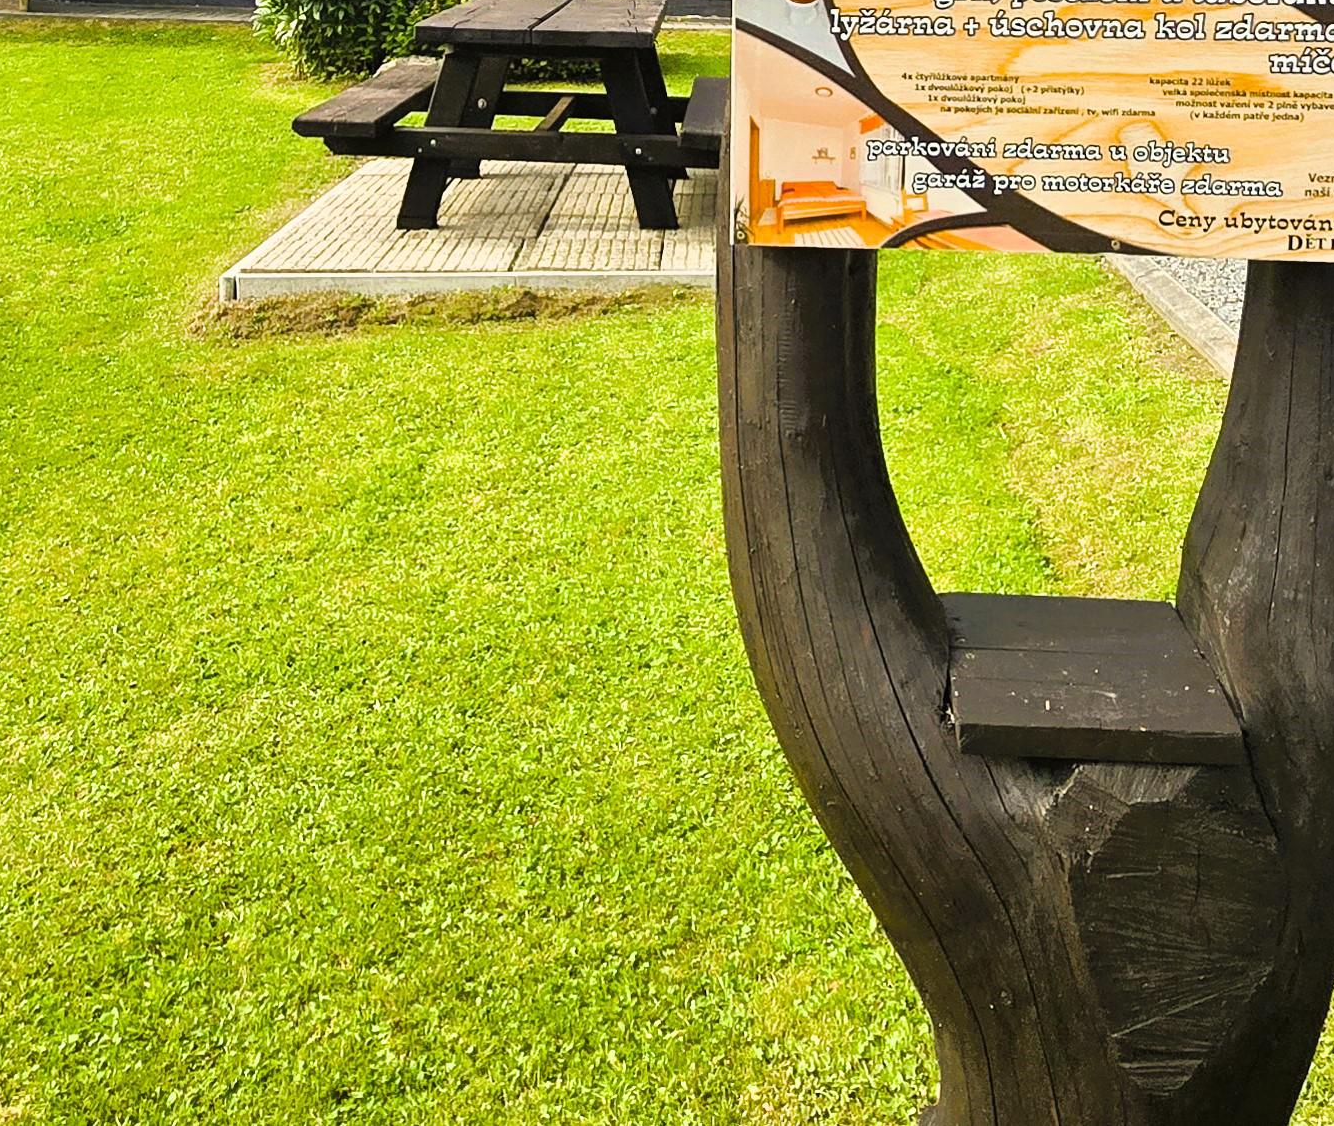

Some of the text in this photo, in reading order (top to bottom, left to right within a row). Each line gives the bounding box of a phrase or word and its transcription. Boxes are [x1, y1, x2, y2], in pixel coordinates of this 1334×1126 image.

[829, 7, 956, 42] lyžárna
[963, 17, 981, 36] +
[987, 10, 1147, 40] úschovna
[1154, 12, 1207, 41] kol
[901, 72, 913, 80] 4x
[970, 74, 1020, 84] apartmány
[1149, 77, 1189, 87] kapacita
[1191, 77, 1204, 86] 22
[915, 83, 926, 91] 1x
[987, 86, 1013, 94] pokoj
[928, 94, 938, 102] 1x
[1000, 95, 1026, 105] pokoj
[1162, 88, 1187, 96] velká
[1293, 91, 1333, 102] kapacita
[1175, 99, 1217, 108] možnost
[940, 105, 952, 113] na
[995, 106, 1004, 115] je
[1101, 108, 1119, 116] wifi
[1121, 108, 1156, 117] zdarma
[1202, 110, 1241, 119] každém
[1243, 112, 1269, 121] patře
[1271, 112, 1305, 122] jedna)
[866, 136, 1231, 168] parkování zdarma u objektu
[913, 169, 1283, 196] garáž pro motorkáře zdarma
[1158, 210, 1216, 232] Ceny
